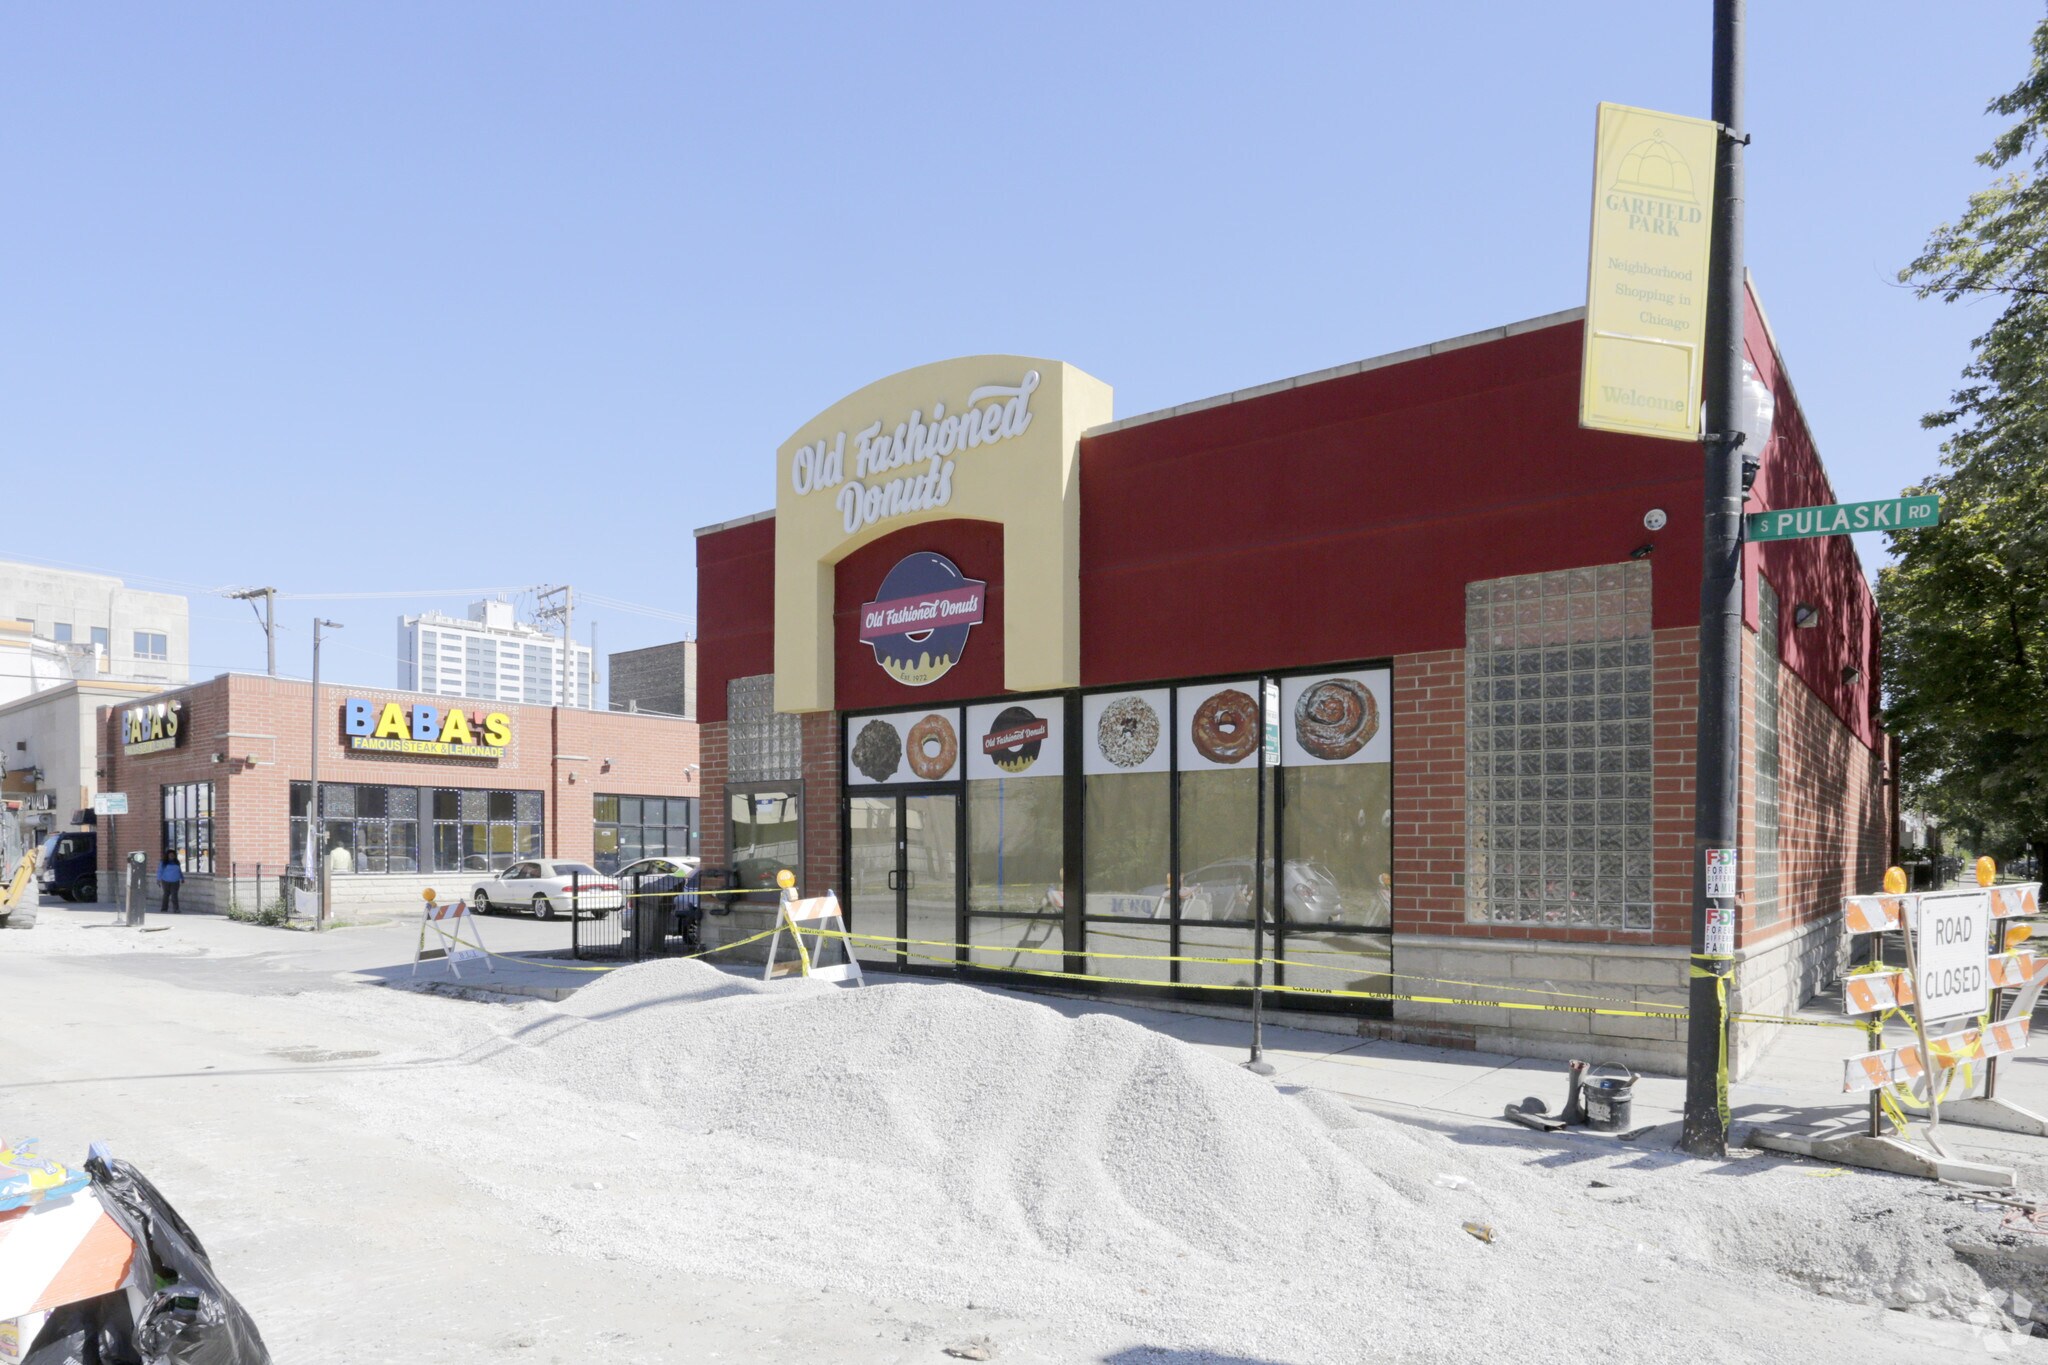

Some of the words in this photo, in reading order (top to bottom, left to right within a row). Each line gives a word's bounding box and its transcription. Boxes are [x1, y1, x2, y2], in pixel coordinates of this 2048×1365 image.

[1605, 193, 1702, 224] GARFIELD
[1628, 214, 1680, 237] PARK
[1607, 256, 1693, 282] Neighborhood
[1615, 283, 1676, 305] Shopping
[1679, 293, 1692, 306] in
[1639, 311, 1690, 331] Chicago
[1601, 385, 1685, 413] Welcome
[792, 431, 847, 496] Old
[855, 369, 1041, 479] Fashioned
[835, 454, 955, 534] Donuts
[1760, 520, 1769, 533] S
[1777, 502, 1902, 536] PULASKI
[1908, 504, 1931, 519] RD
[865, 610, 885, 628] Old
[886, 599, 940, 625] Fashioned
[940, 594, 979, 617] Donuts
[122, 700, 180, 745] BABA'S
[345, 697, 512, 747] BABA'S
[353, 737, 401, 751] FAMOUS
[402, 741, 438, 753] STEAK
[440, 743, 448, 754] &
[450, 744, 504, 757] LEMONADE
[985, 738, 996, 748] Old
[996, 729, 1025, 745] Fashioned
[1025, 725, 1046, 738] Donuts
[1707, 883, 1734, 892] FAMIL
[1935, 915, 1973, 946] ROAD
[1706, 943, 1732, 953] FAMIL
[1925, 964, 1981, 1000] CLOSED
[1368, 992, 1412, 1001] CAUTION
[1452, 999, 1500, 1007] CAUTION
[1544, 1005, 1596, 1014] CAUTION
[1645, 1011, 1691, 1020] CAUTIO
